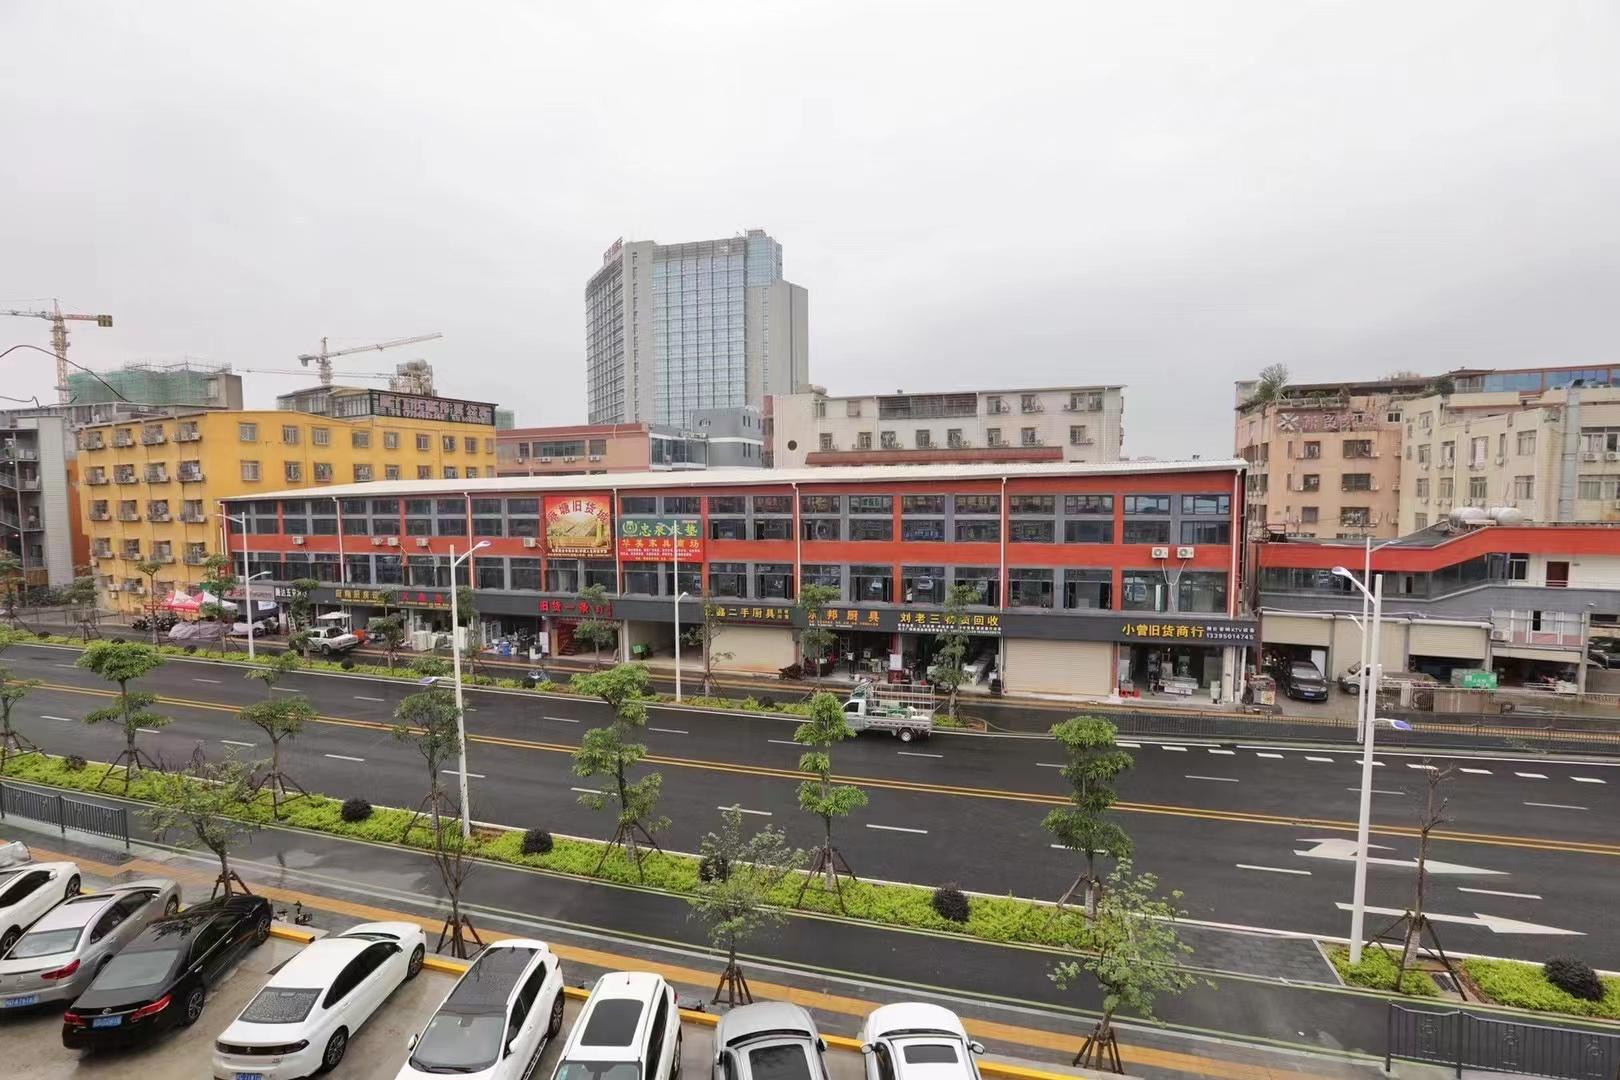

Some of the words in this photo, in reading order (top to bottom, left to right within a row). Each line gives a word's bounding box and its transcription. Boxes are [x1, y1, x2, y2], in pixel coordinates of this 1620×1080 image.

[1122, 623, 1205, 639] 小曾旧货商行
